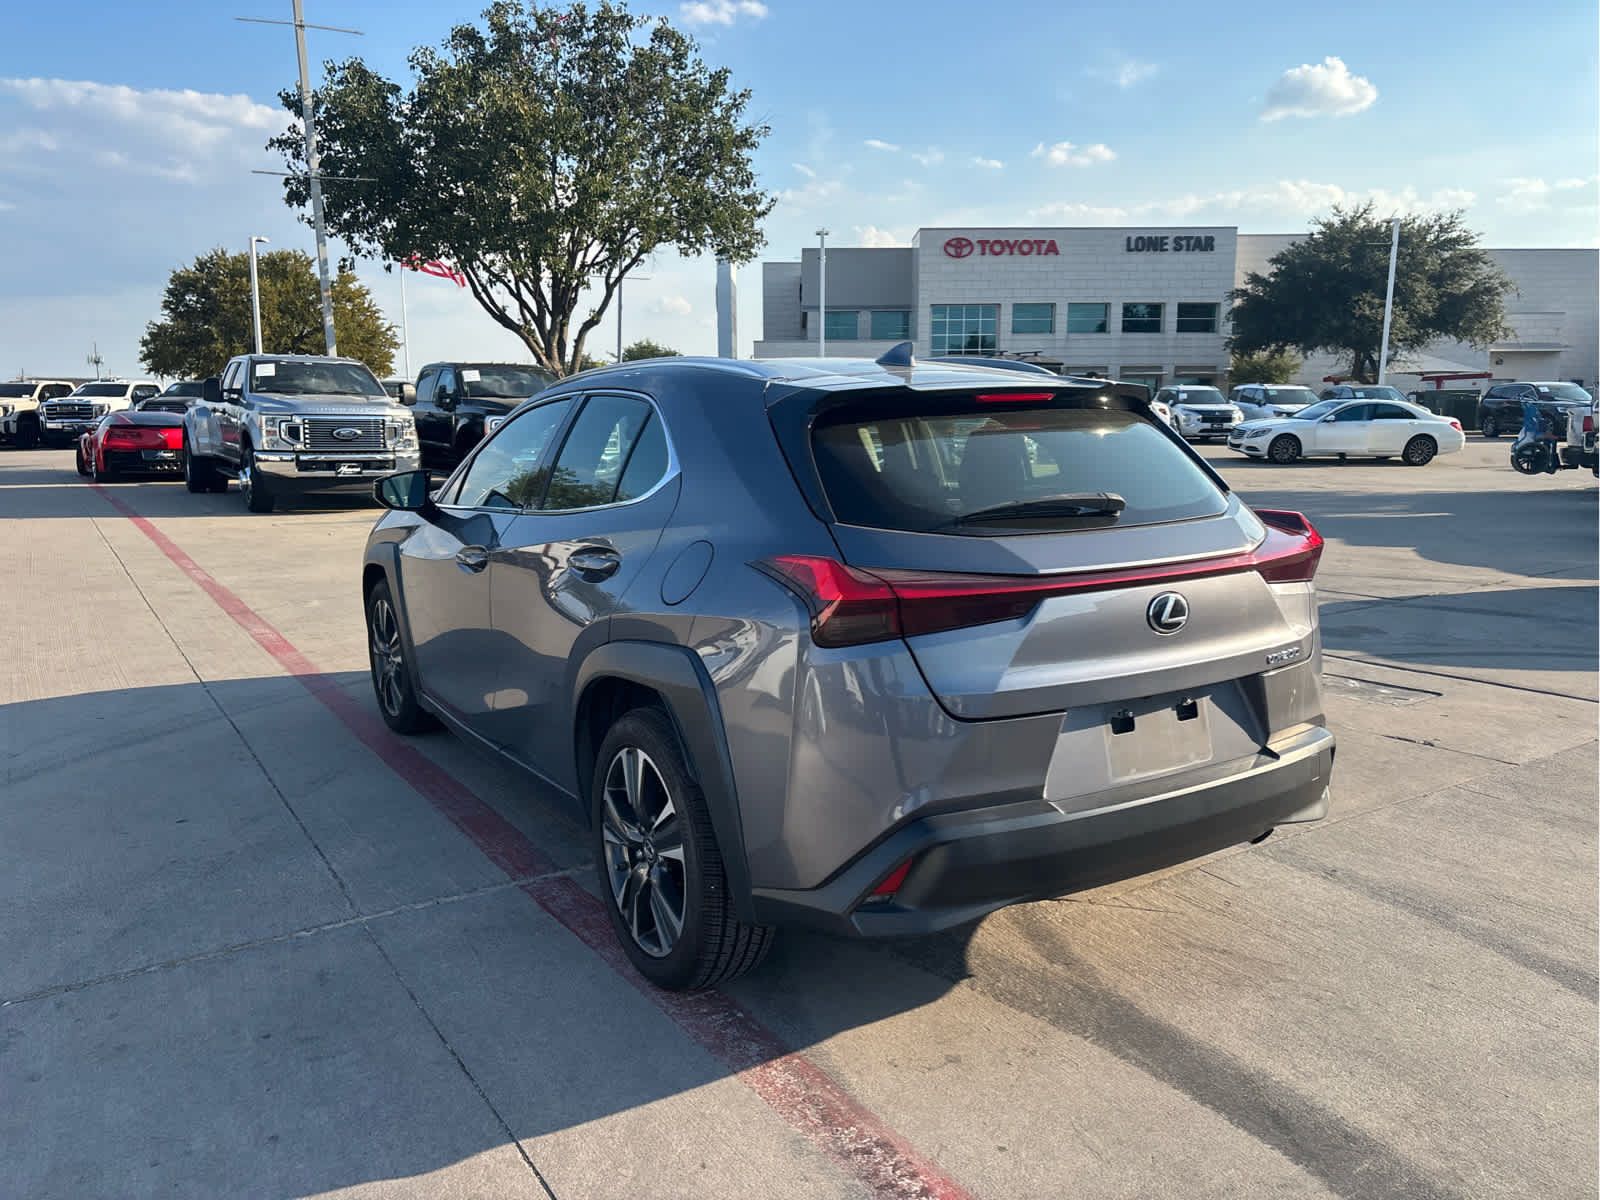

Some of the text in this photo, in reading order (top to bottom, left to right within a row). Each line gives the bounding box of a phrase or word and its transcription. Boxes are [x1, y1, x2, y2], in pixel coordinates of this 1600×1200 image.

[976, 239, 1060, 256] TOYOTA
[1126, 235, 1215, 252] LONE STAR
